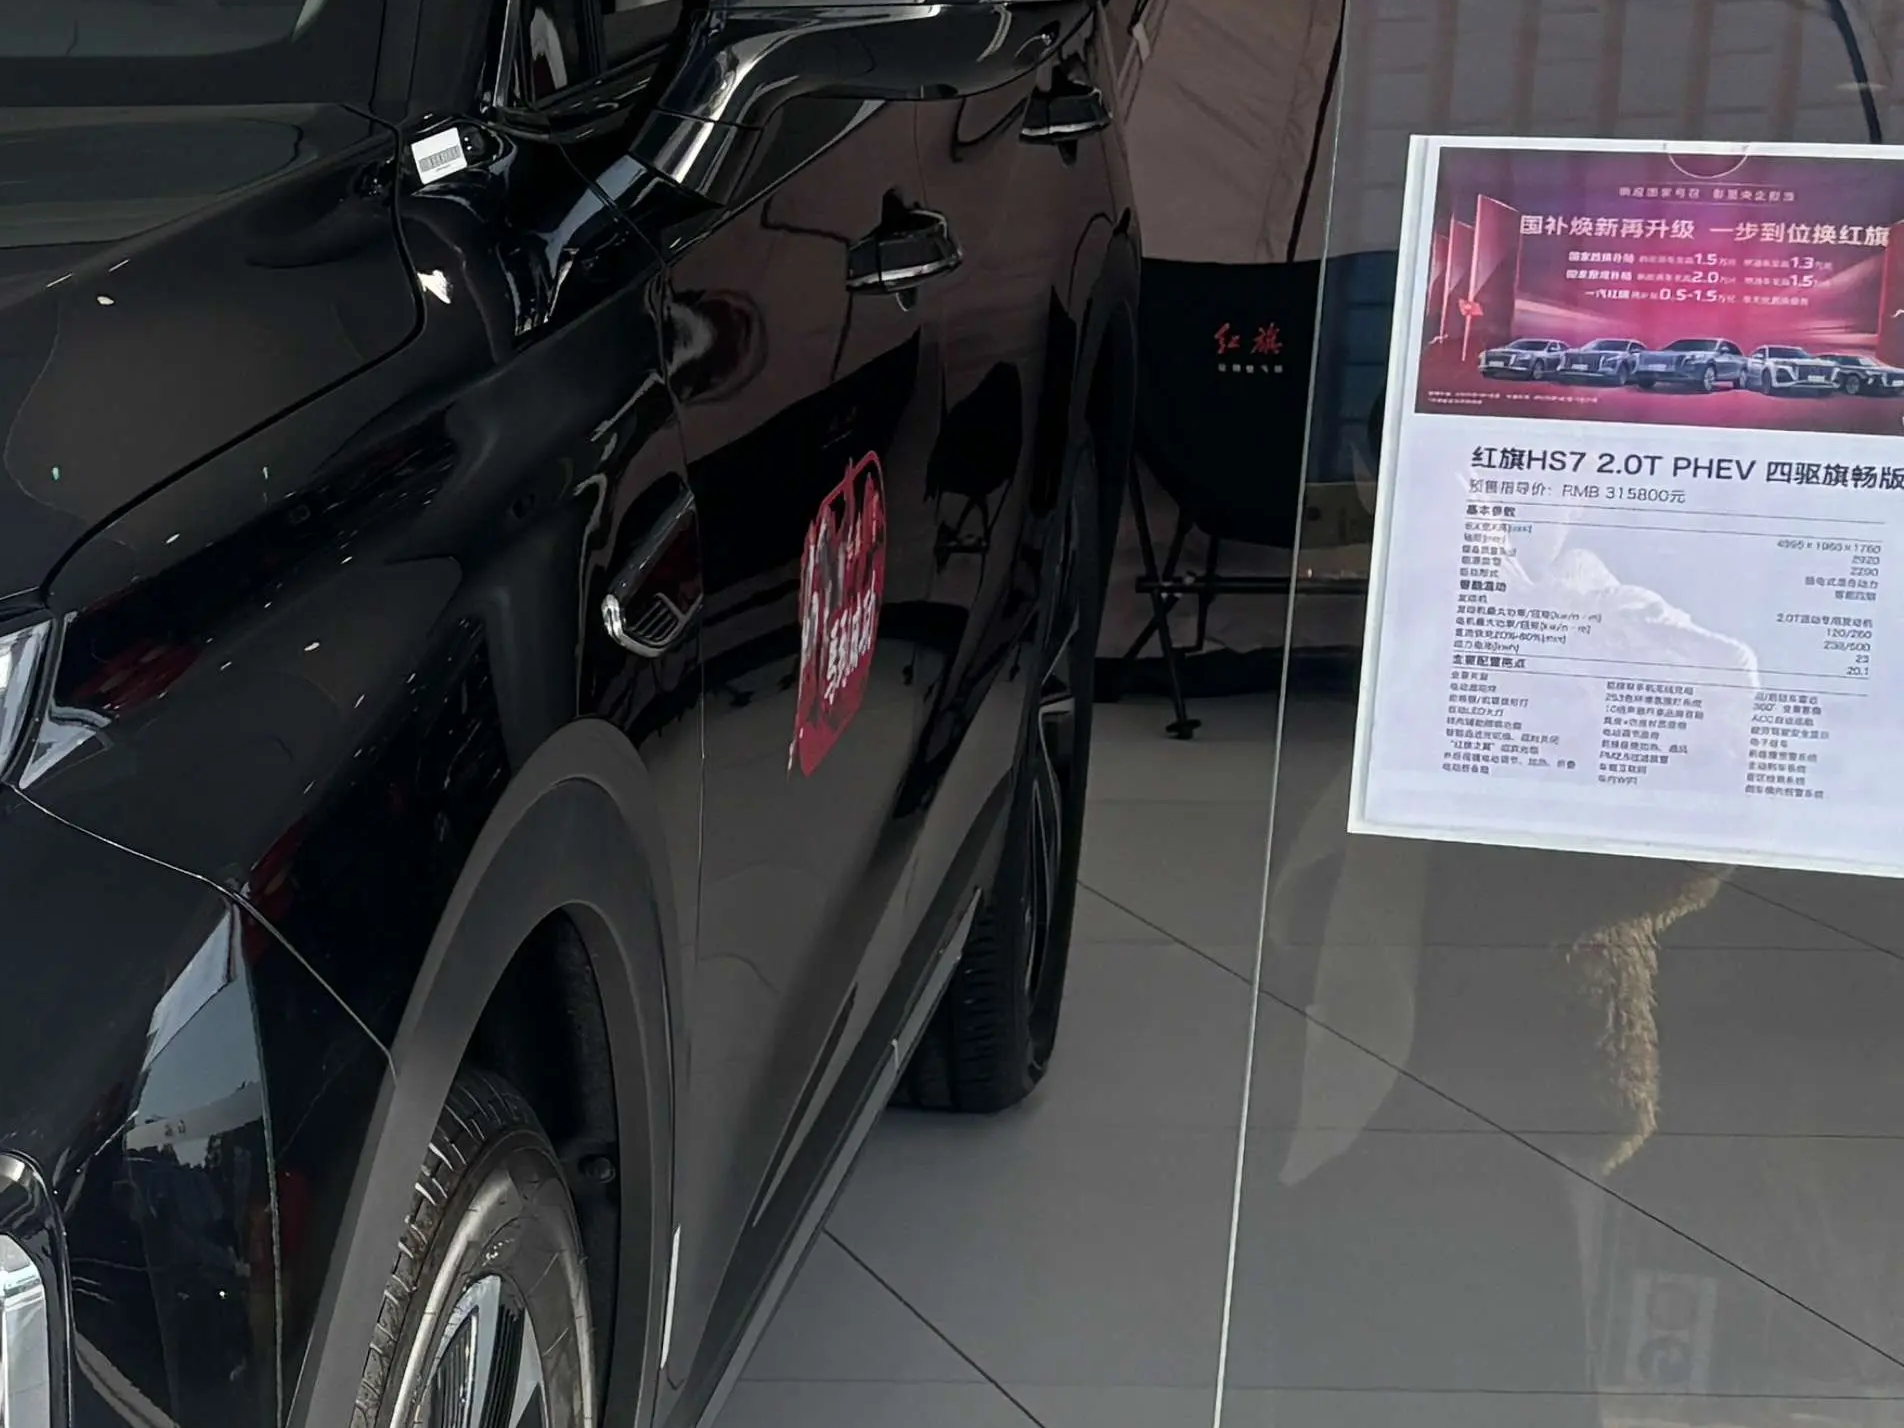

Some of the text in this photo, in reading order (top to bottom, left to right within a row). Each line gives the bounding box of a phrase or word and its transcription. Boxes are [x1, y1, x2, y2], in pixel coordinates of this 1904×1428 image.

[1520, 214, 1892, 249] 国补焕新再升级 一步到位换红旗
[1471, 445, 1586, 473] 红旗HS7
[1596, 452, 1664, 476] 2.0T
[1672, 456, 1757, 481] PHEV
[1562, 484, 1600, 498] RMB
